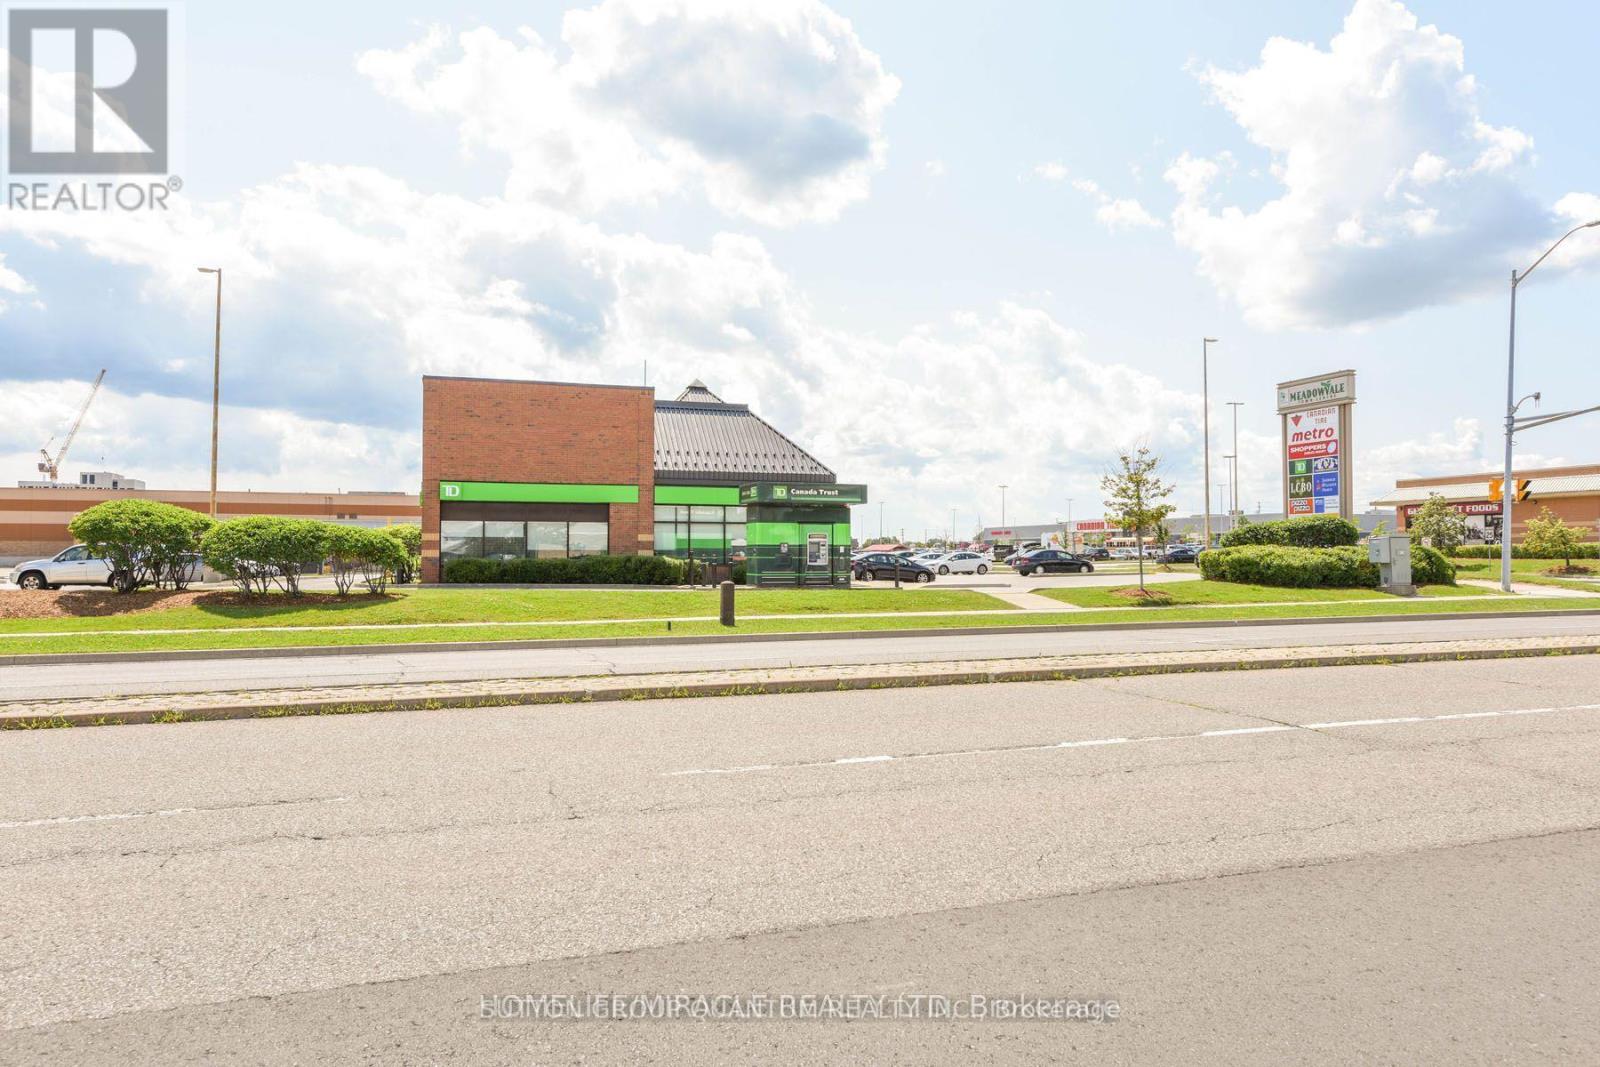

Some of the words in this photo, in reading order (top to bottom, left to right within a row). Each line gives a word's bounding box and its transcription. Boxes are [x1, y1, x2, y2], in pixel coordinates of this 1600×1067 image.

[1290, 383, 1345, 402] MEADOWVALE
[1292, 426, 1334, 442] metro
[1290, 443, 1327, 454] SHOPPERS
[442, 485, 460, 497] TD
[775, 487, 786, 497] TD
[790, 488, 818, 496] Canada
[1290, 481, 1312, 494] LCBO
[1465, 503, 1499, 513] FOODS
